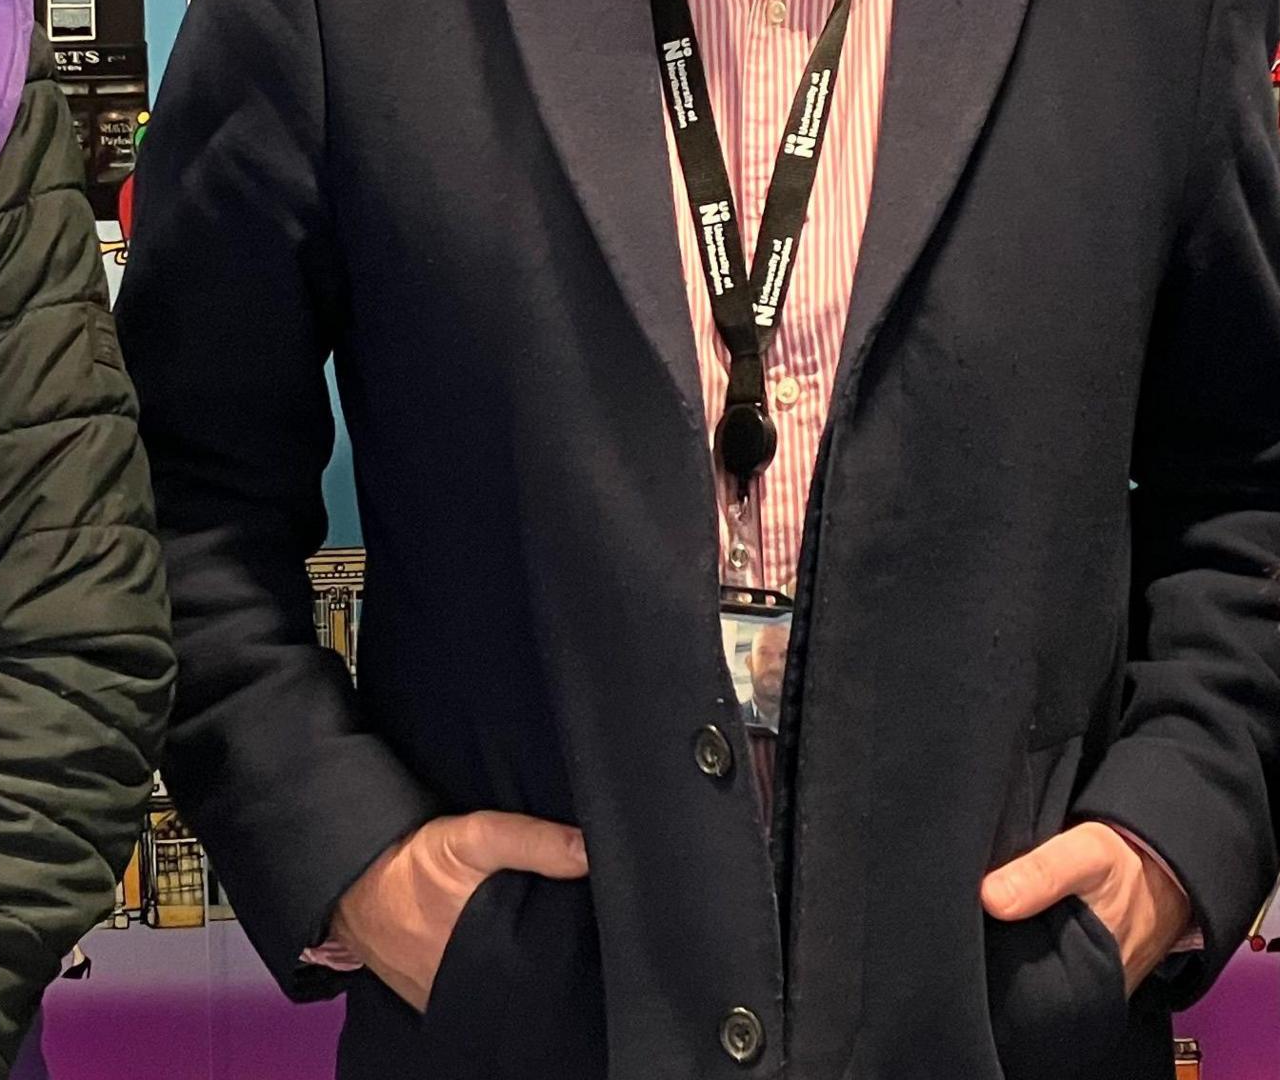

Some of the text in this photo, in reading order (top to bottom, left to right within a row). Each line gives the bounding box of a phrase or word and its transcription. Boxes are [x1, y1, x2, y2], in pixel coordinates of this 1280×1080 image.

[666, 61, 688, 129] Northampton
[677, 59, 698, 122] University of
[798, 72, 821, 136] University of
[808, 69, 832, 138] Northampton
[703, 225, 724, 296] Northampton
[713, 223, 735, 289] University of
[759, 239, 783, 304] University of
[768, 236, 793, 307] Northampton
